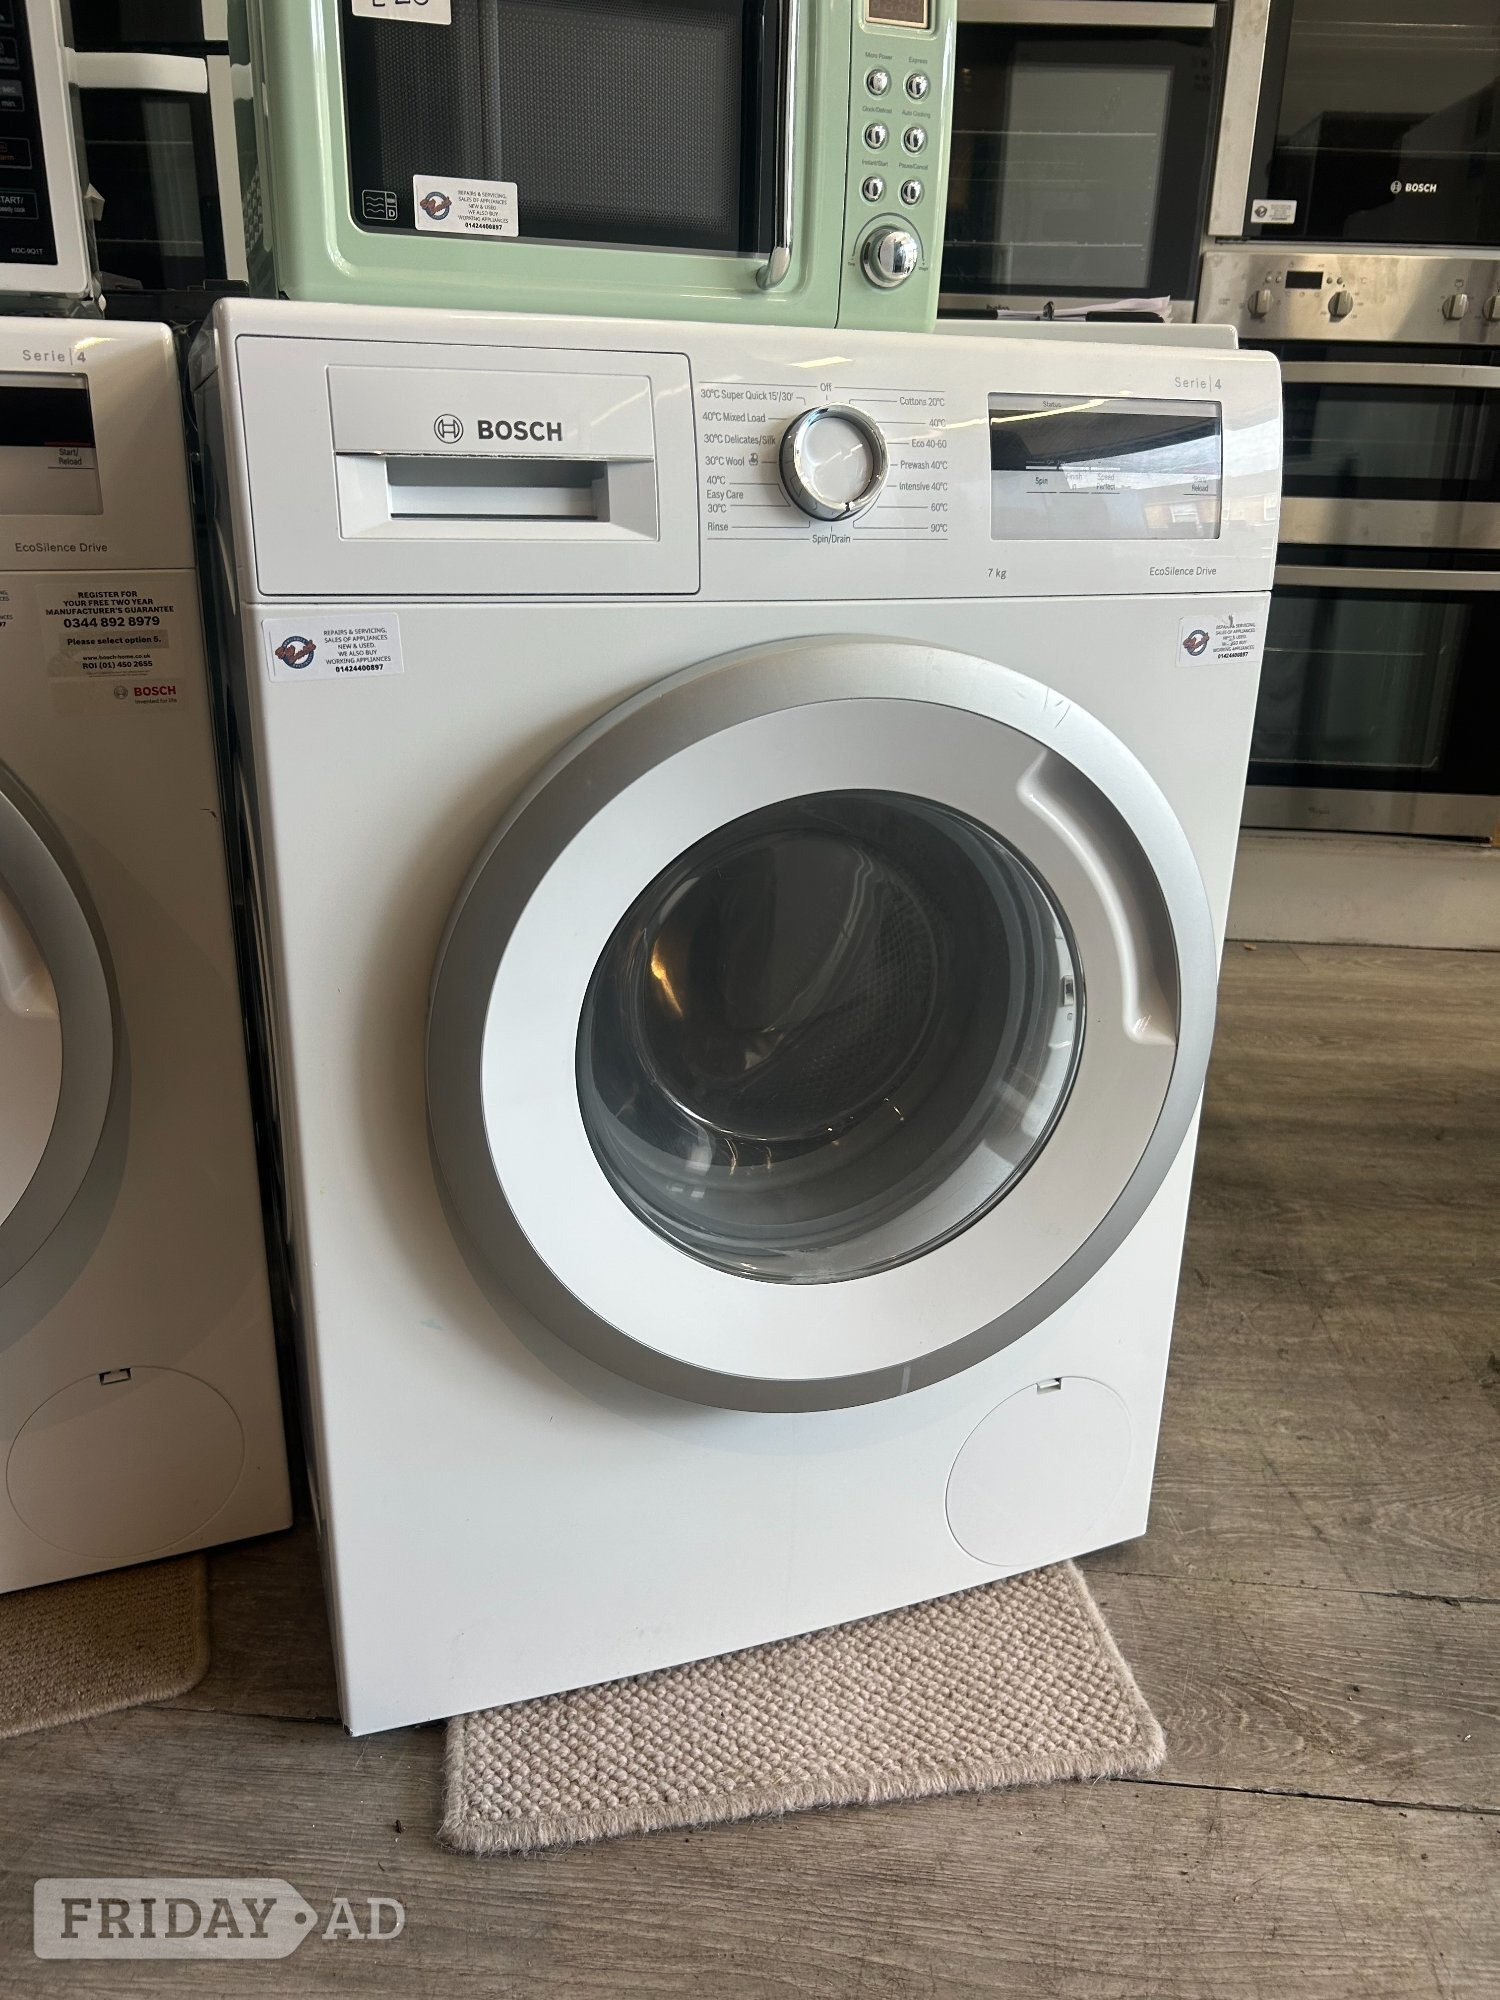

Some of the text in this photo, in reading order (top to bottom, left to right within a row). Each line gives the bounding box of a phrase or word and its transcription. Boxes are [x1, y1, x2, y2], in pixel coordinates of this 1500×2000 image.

[1405, 183, 1437, 192] BOSCH
[0, 195, 24, 204] TART/
[820, 383, 832, 392] Off
[721, 390, 744, 401] Super
[746, 391, 767, 401] Quick
[900, 397, 927, 406] Cottons
[723, 412, 746, 422] Mixed
[747, 413, 766, 422] Load
[477, 420, 563, 441] BOSCH
[724, 434, 776, 446] Delicates/Silk
[911, 439, 947, 448] Eco 40-60
[59, 457, 82, 466] Reload
[725, 456, 744, 466] Wool
[900, 460, 929, 470] Prewash
[1035, 477, 1048, 486] Spin
[900, 482, 930, 491] Intensive
[707, 490, 744, 500] Easy Care
[708, 522, 729, 531] Rinse
[812, 535, 851, 544] Spin/Drain
[15, 543, 108, 552] EcoSilence Drive
[988, 568, 1006, 579] 7 kg
[1150, 566, 1217, 576] EcoSilence Drive
[78, 591, 119, 599] REGISTER
[45, 607, 123, 616] MANUFACTURER'S
[63, 616, 160, 628] 0344 892 8979
[67, 638, 95, 646] Please
[97, 637, 123, 645] select
[125, 636, 151, 645] option
[82, 662, 97, 670] ROI
[99, 662, 116, 670] (01)
[335, 664, 384, 673] 01424400897
[134, 686, 177, 697] BOSCH
